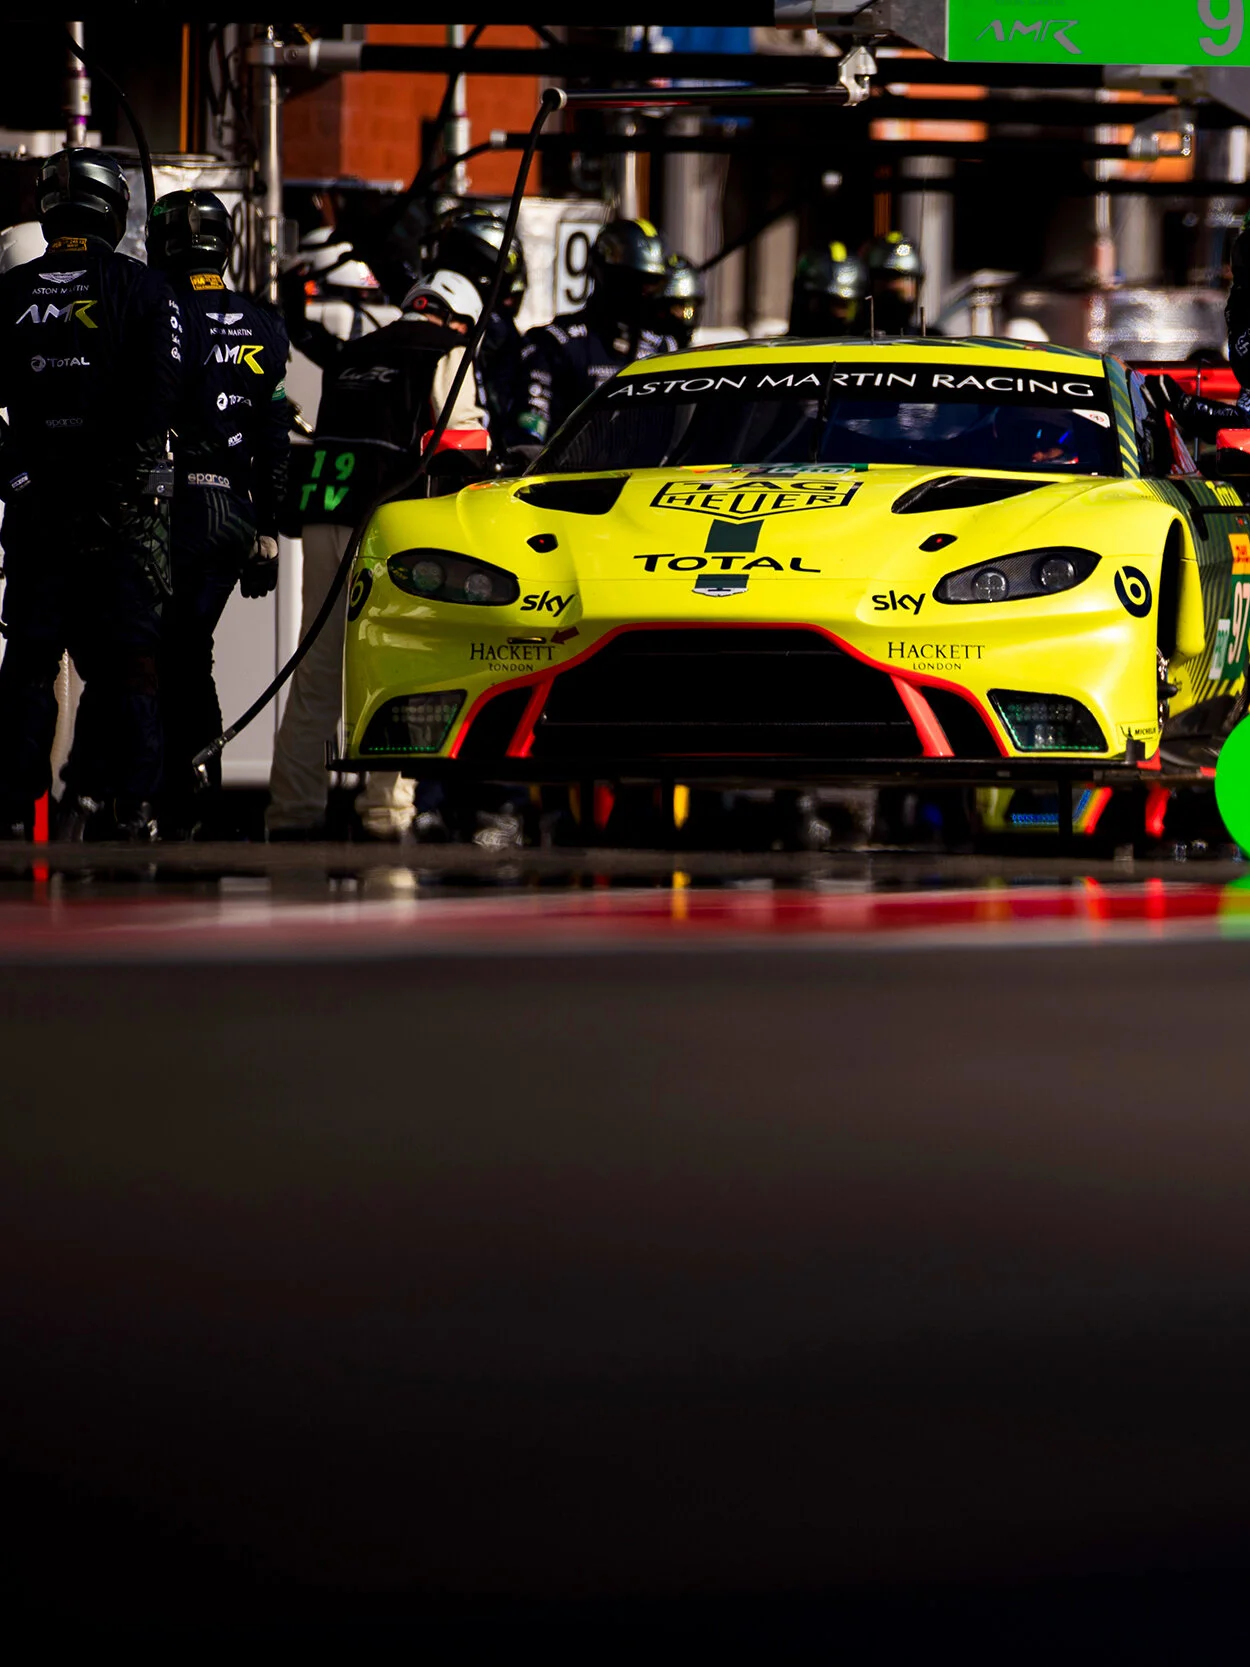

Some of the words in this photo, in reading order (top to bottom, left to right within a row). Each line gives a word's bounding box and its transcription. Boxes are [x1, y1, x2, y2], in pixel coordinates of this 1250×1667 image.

[976, 20, 1083, 54] AMR
[32, 287, 58, 295] ASTON
[16, 300, 98, 328] AMR
[47, 356, 90, 368] TOTAL
[204, 344, 264, 374] AMR
[608, 376, 747, 398] ASTON
[757, 373, 917, 388] MARTIN
[932, 374, 1094, 397] RACING
[311, 450, 355, 480] 19
[188, 473, 230, 488] sparco
[684, 481, 839, 491] TAG
[300, 484, 349, 511] TV
[666, 494, 837, 514] HEUER
[633, 553, 821, 573] TOTAL
[520, 591, 574, 617] sky
[872, 590, 926, 615] sky
[1228, 581, 1250, 664] 97
[470, 642, 556, 660] HACKETT
[888, 641, 985, 659] HACKETT
[489, 662, 534, 672] LONDON
[913, 662, 962, 670] LONDON
